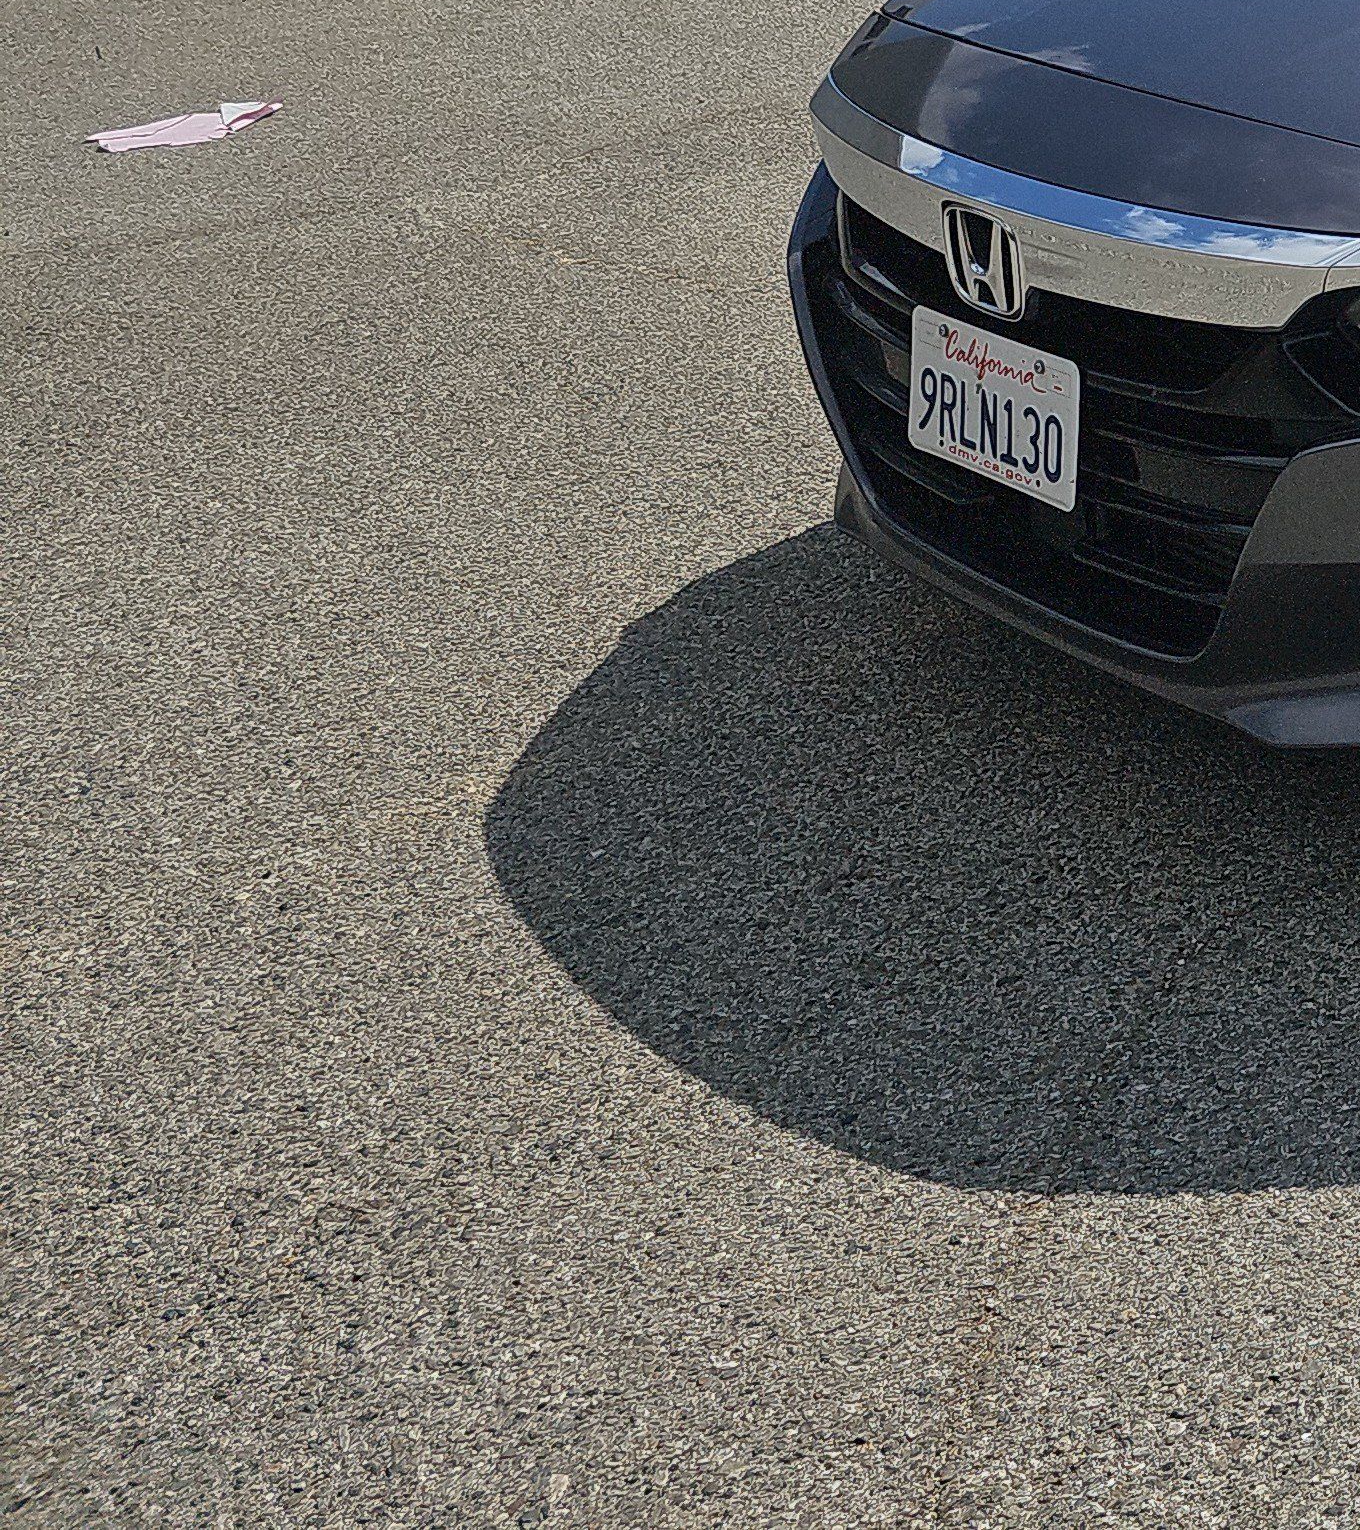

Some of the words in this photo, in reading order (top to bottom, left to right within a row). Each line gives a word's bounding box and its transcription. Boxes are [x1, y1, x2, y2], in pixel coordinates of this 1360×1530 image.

[946, 330, 1046, 393] California
[918, 368, 1063, 483] 9RLN130
[949, 445, 1033, 486] dmv.ca.gov
